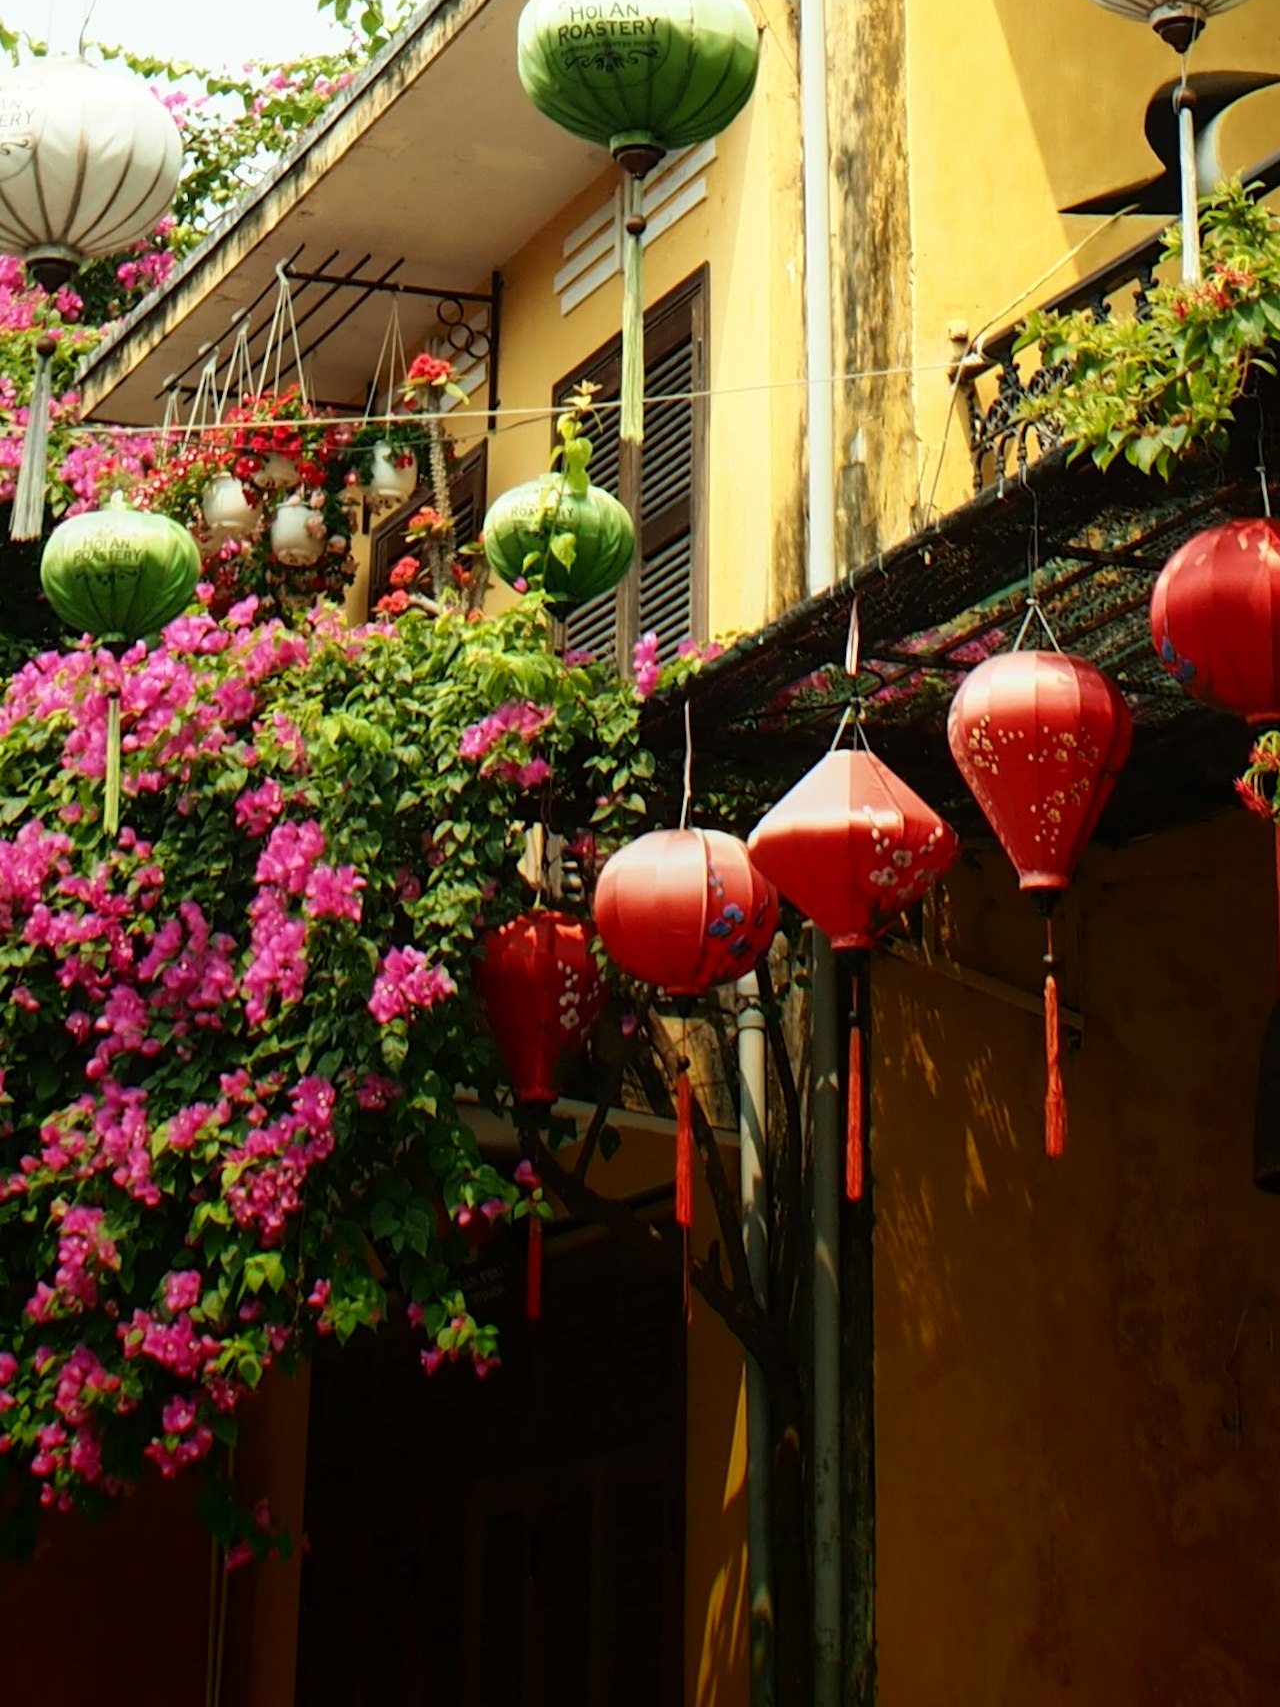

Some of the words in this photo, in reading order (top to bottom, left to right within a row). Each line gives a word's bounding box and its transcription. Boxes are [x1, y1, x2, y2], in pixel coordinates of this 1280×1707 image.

[569, 3, 604, 23] HOI
[609, 0, 641, 18] AN
[557, 15, 659, 47] ROASTERY
[109, 535, 131, 550] AN
[73, 548, 143, 566] ROASTERY
